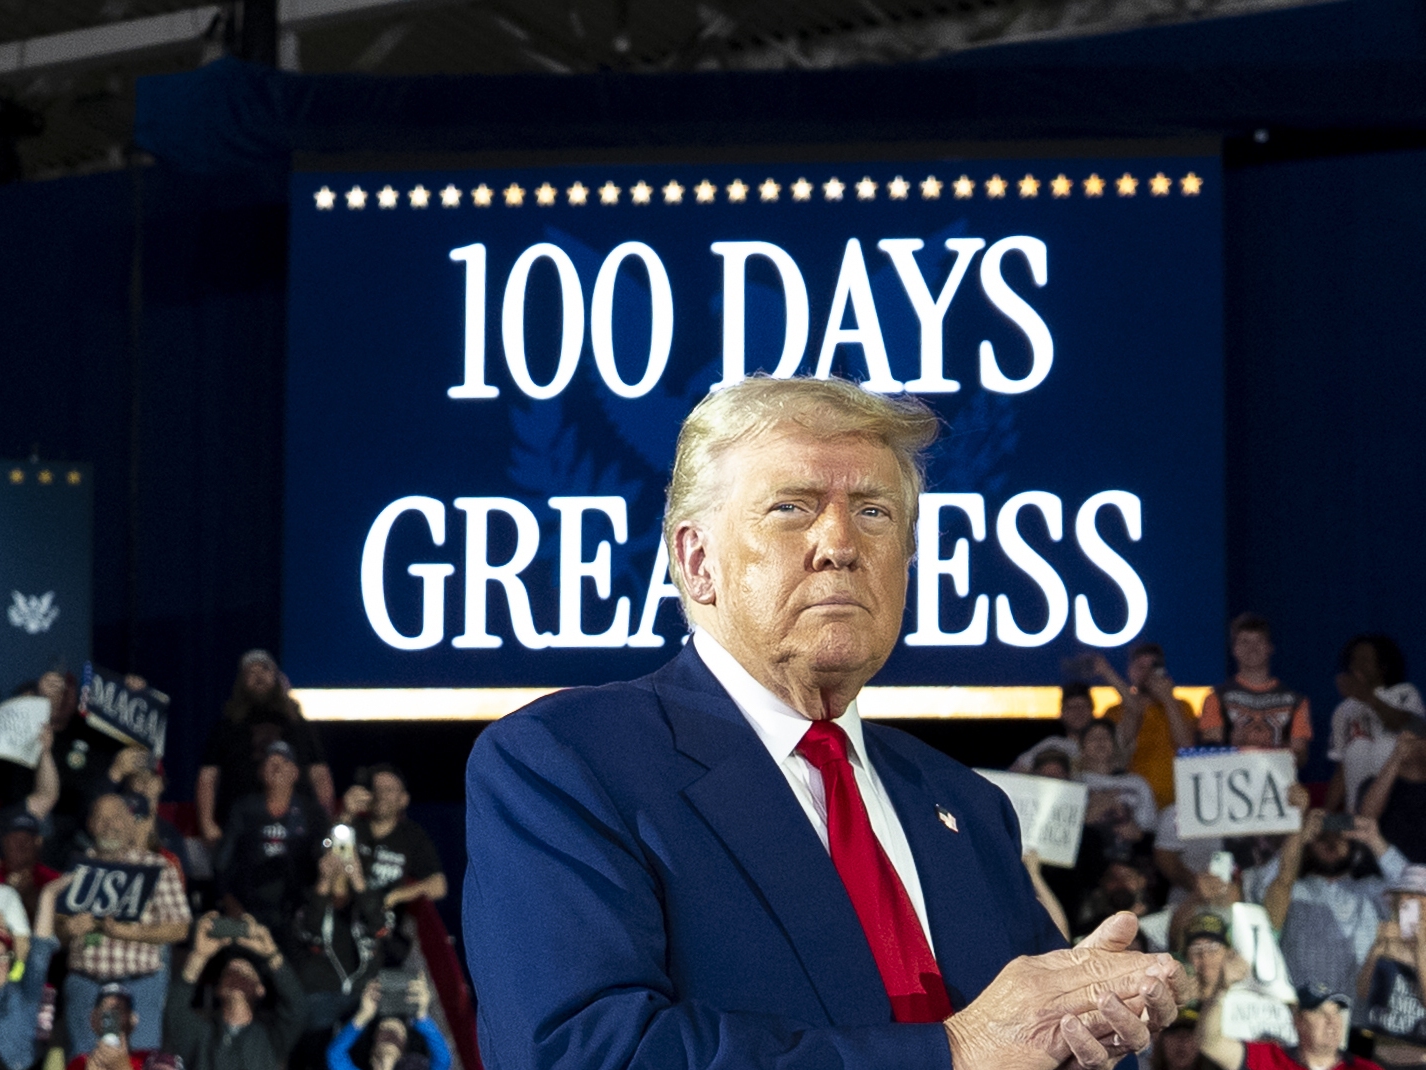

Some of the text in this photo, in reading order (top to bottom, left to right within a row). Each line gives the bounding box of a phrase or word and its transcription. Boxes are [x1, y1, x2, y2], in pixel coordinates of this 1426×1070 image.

[447, 234, 1055, 400] 100 DAYS
[92, 673, 166, 758] MAGA
[1191, 768, 1286, 827] USA
[65, 863, 145, 918] USA
